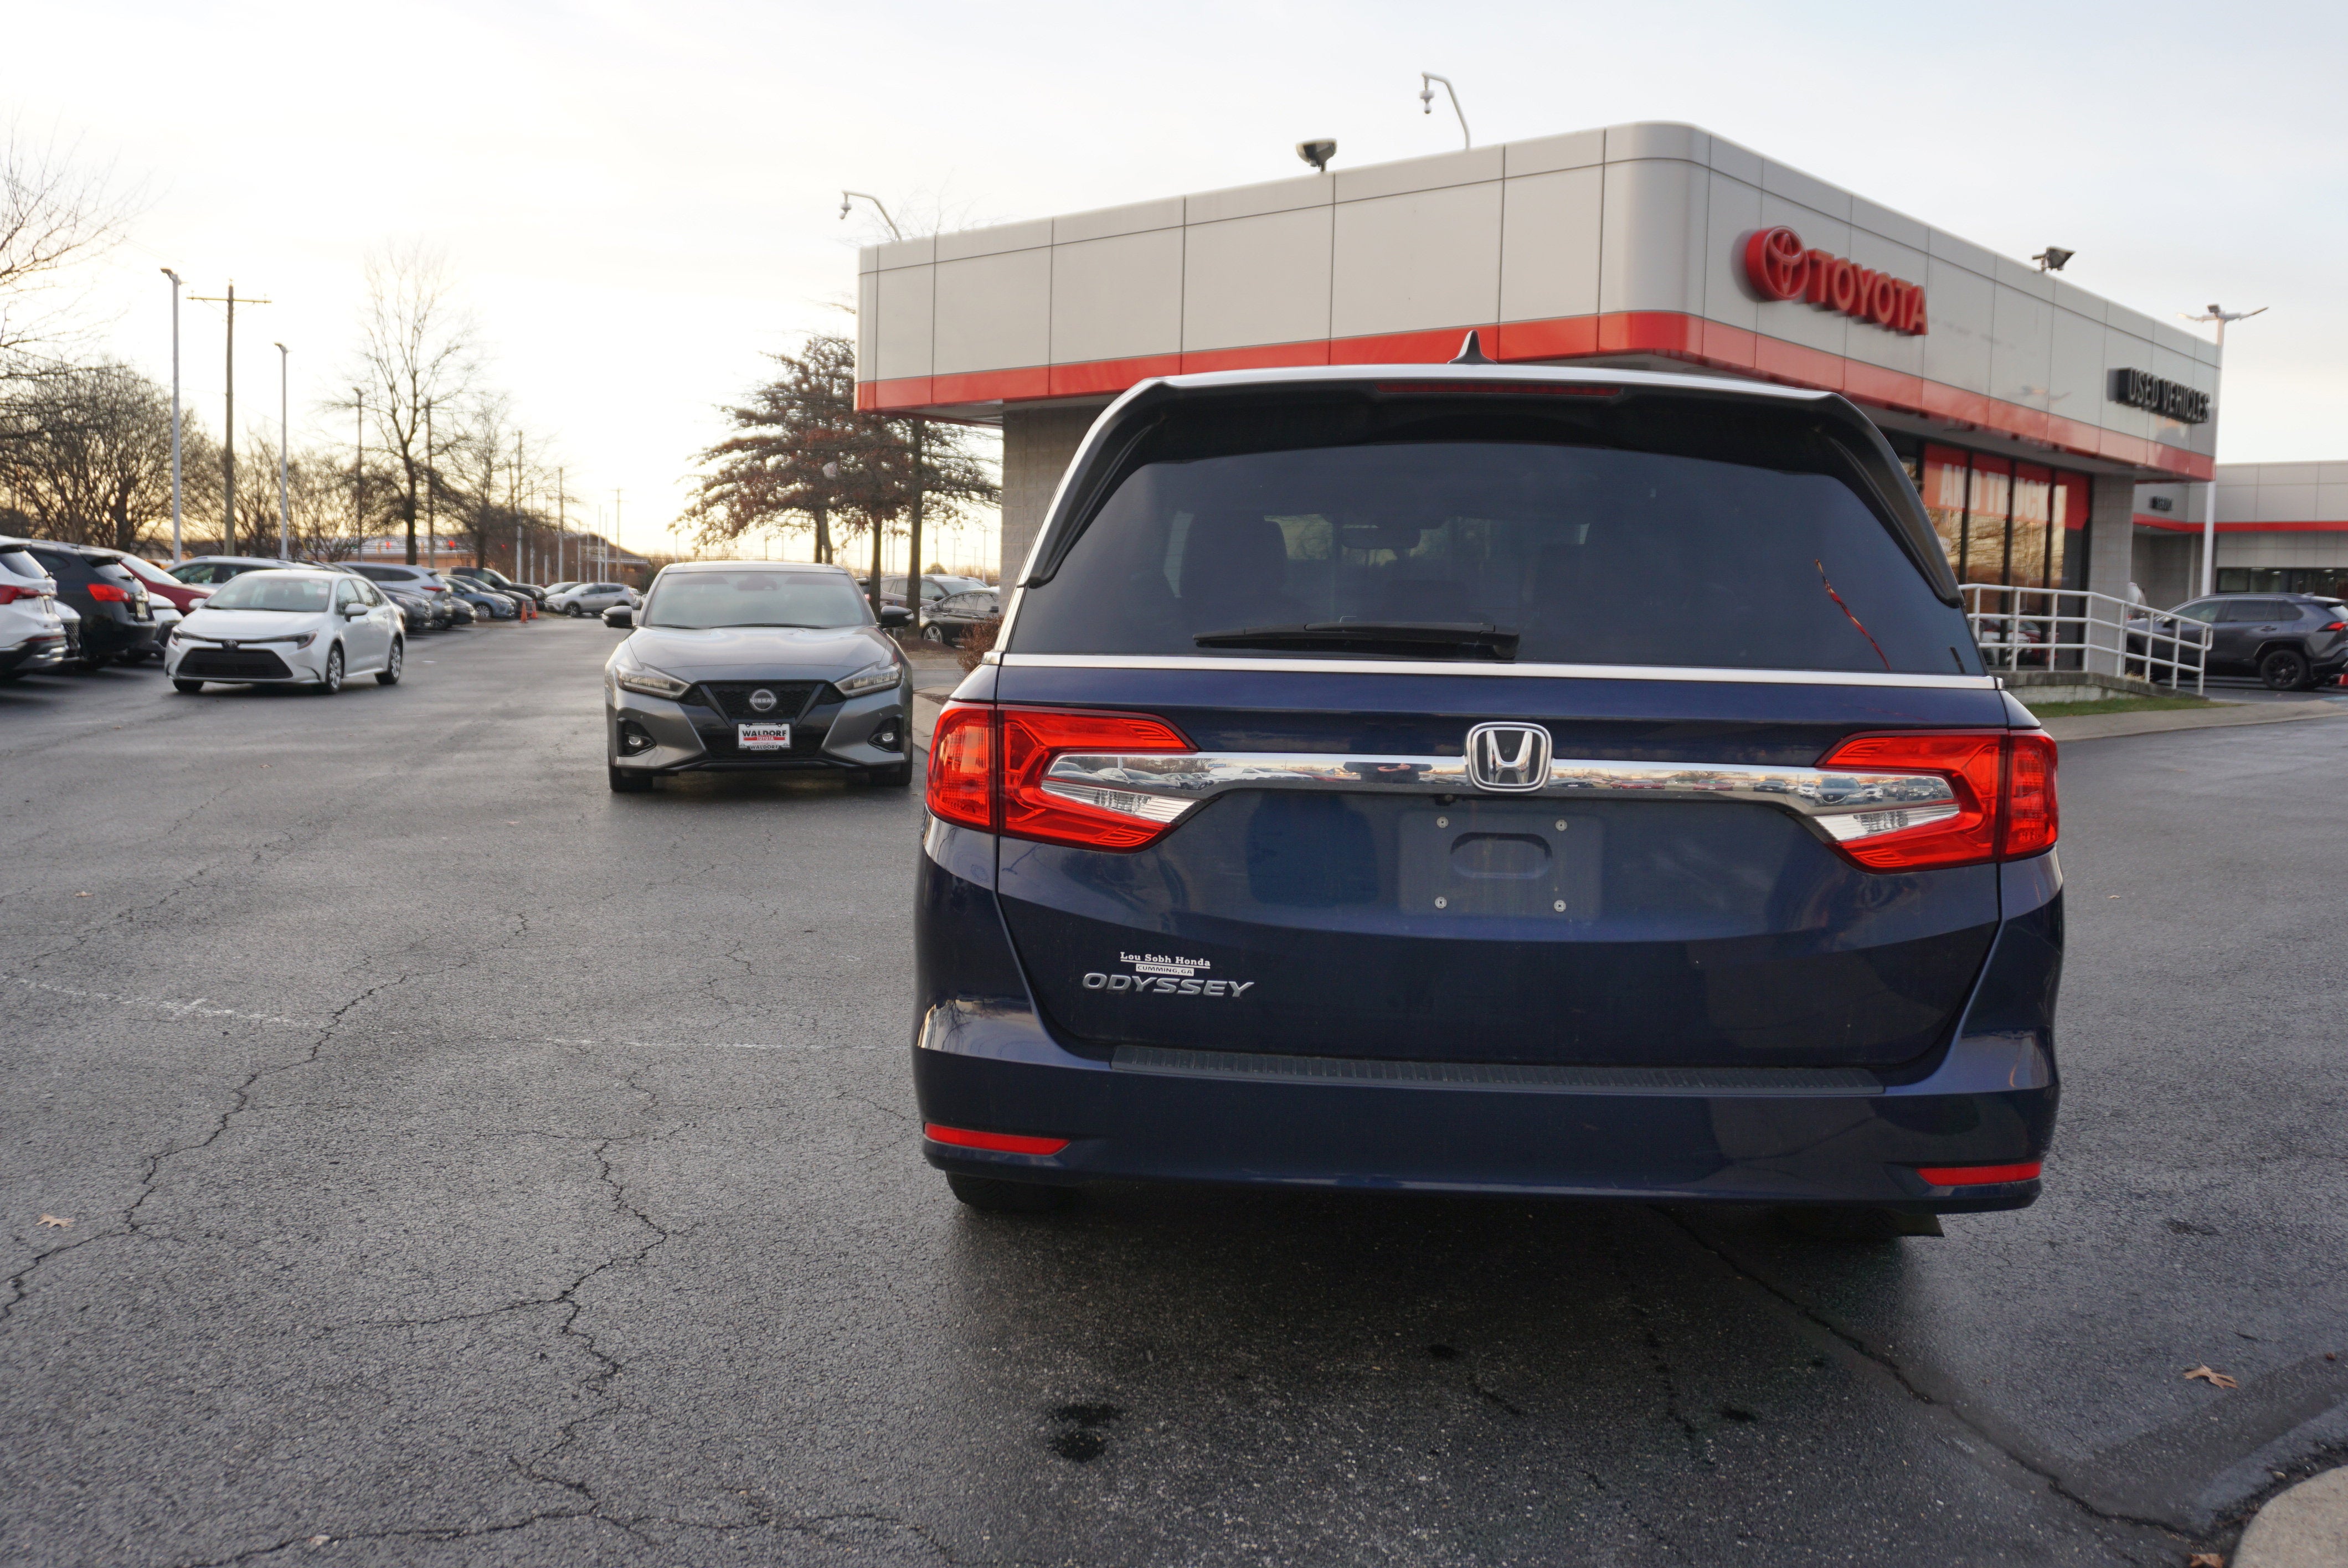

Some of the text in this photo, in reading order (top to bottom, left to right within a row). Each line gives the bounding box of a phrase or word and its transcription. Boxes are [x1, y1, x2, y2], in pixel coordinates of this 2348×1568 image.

[1807, 249, 1928, 335] TOYOTA
[2126, 367, 2210, 423] USED VEHICLES
[1940, 463, 2067, 523] AND TRUCKS
[1082, 972, 1255, 997] ODYSSEY
[1120, 952, 1211, 966] Lou Sobh Honda
